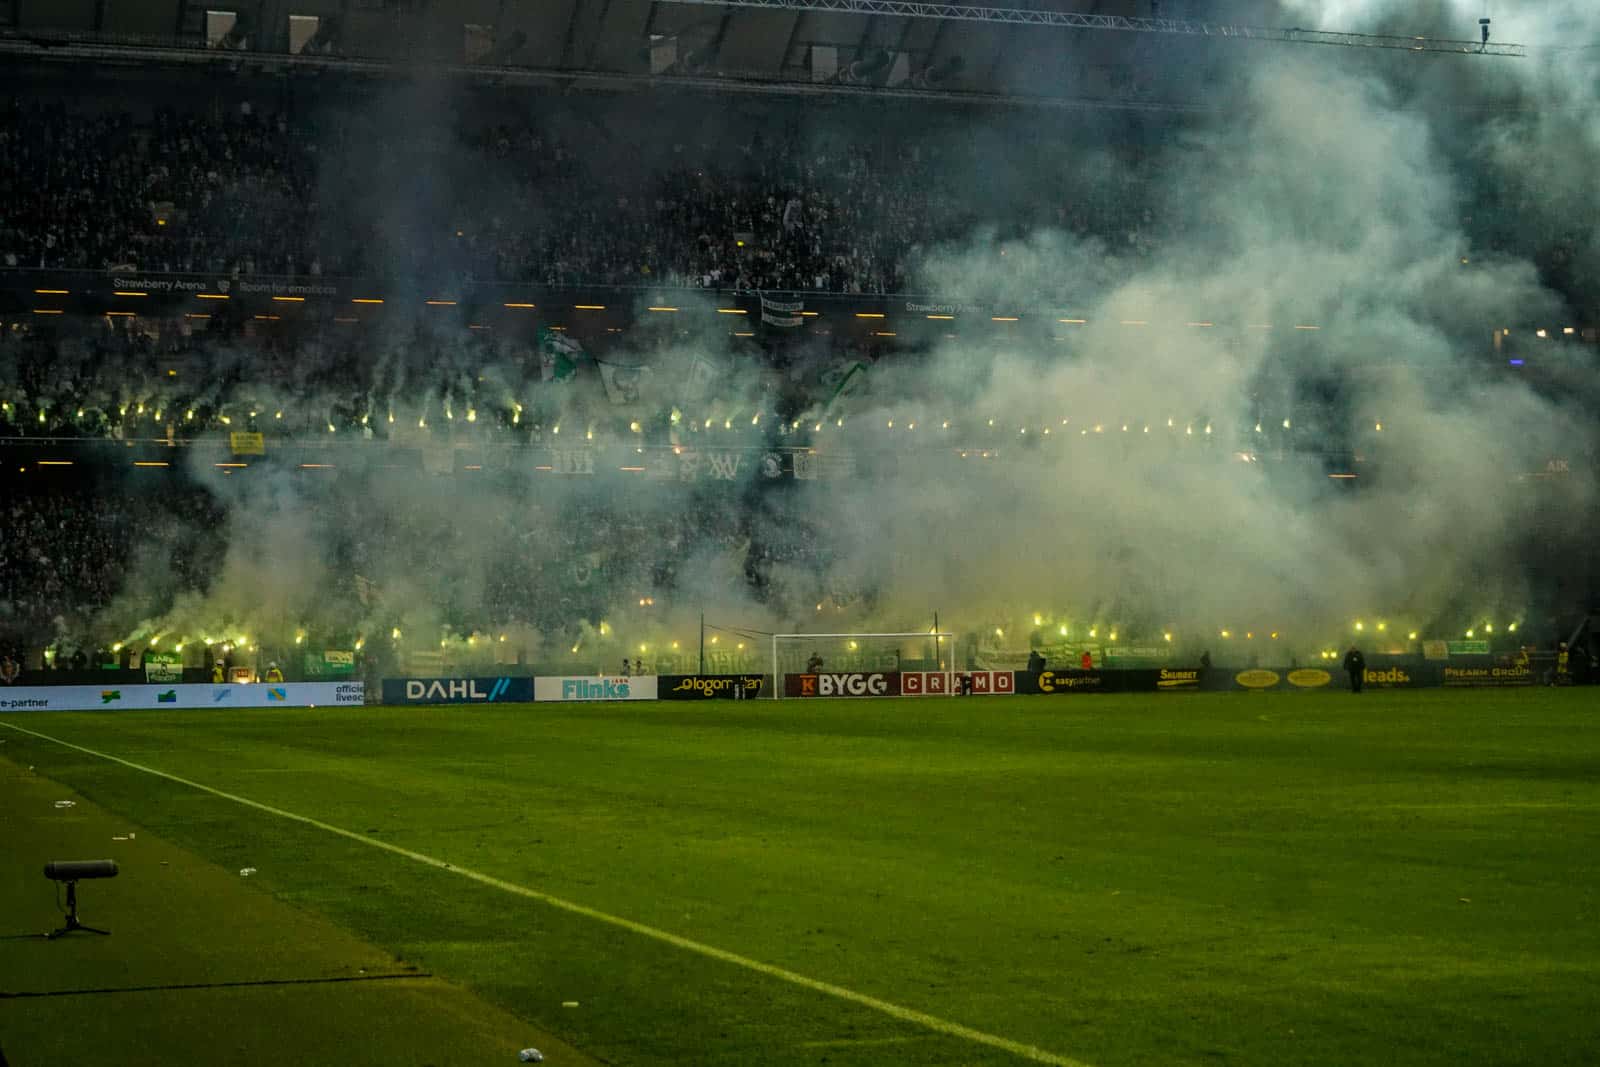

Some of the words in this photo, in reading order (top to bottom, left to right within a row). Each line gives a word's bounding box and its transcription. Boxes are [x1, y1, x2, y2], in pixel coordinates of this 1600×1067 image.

[114, 278, 173, 291] Strawberry
[174, 280, 206, 290] Arena
[906, 302, 955, 313] Strawberry
[406, 679, 487, 699] DAHL
[562, 679, 630, 699] Flinks
[818, 674, 888, 695] BYGG
[0, 699, 48, 708] e-partner
